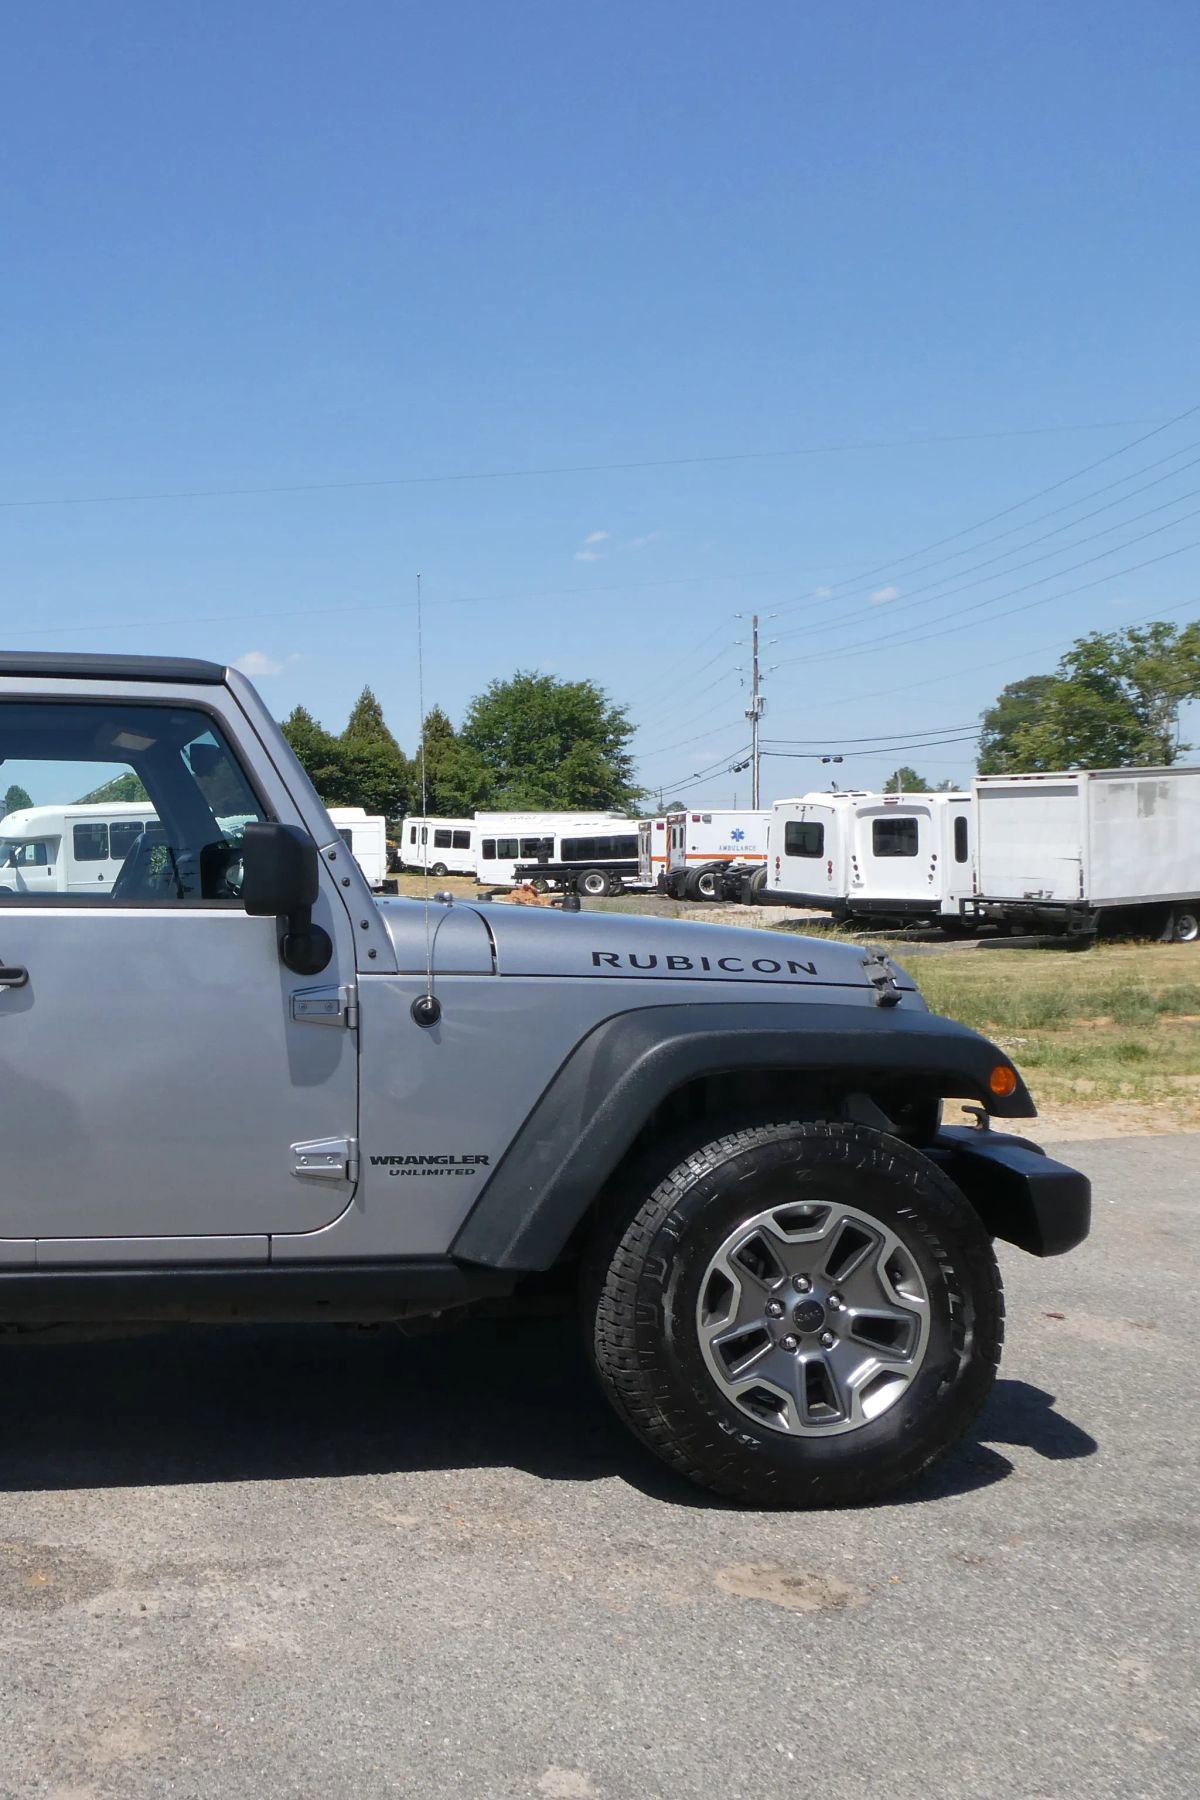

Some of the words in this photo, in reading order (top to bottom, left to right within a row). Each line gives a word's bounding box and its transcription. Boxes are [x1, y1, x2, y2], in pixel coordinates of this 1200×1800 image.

[591, 951, 818, 976] RUBICON
[369, 1155, 490, 1166] WRANGLER
[389, 1168, 476, 1177] UNLIMITED
